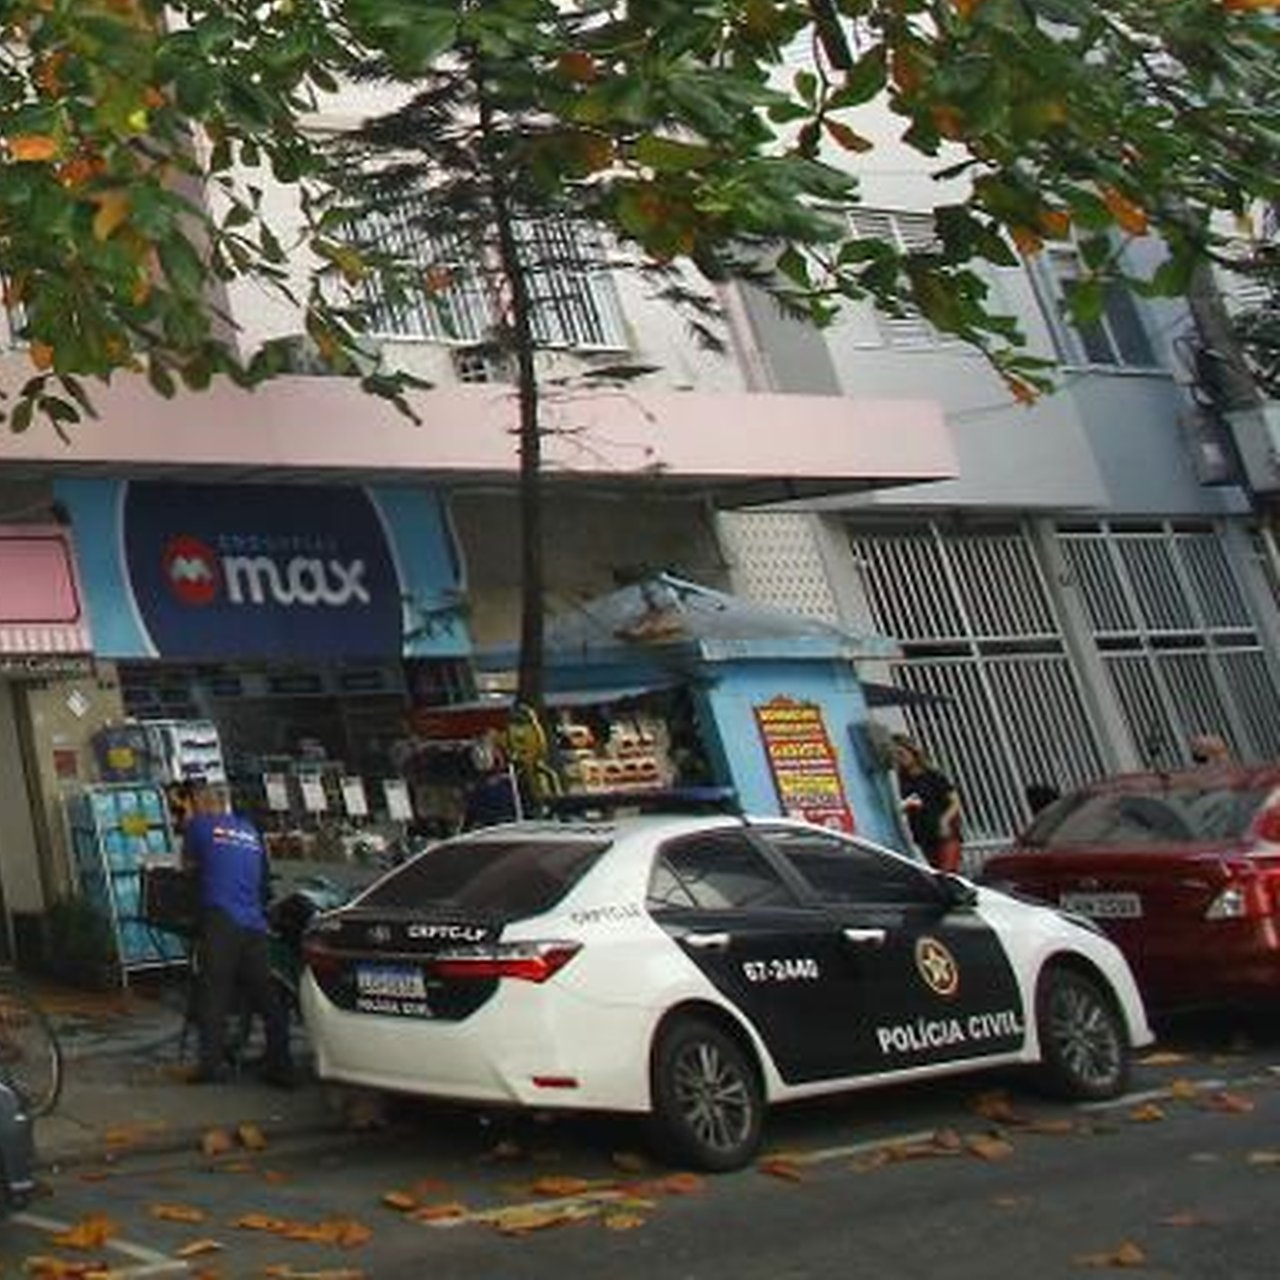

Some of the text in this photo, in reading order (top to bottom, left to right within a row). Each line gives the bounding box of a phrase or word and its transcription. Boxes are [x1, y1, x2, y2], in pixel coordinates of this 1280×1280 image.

[222, 555, 371, 605] max
[876, 1010, 1026, 1054] POLÍCIA CIVIL
